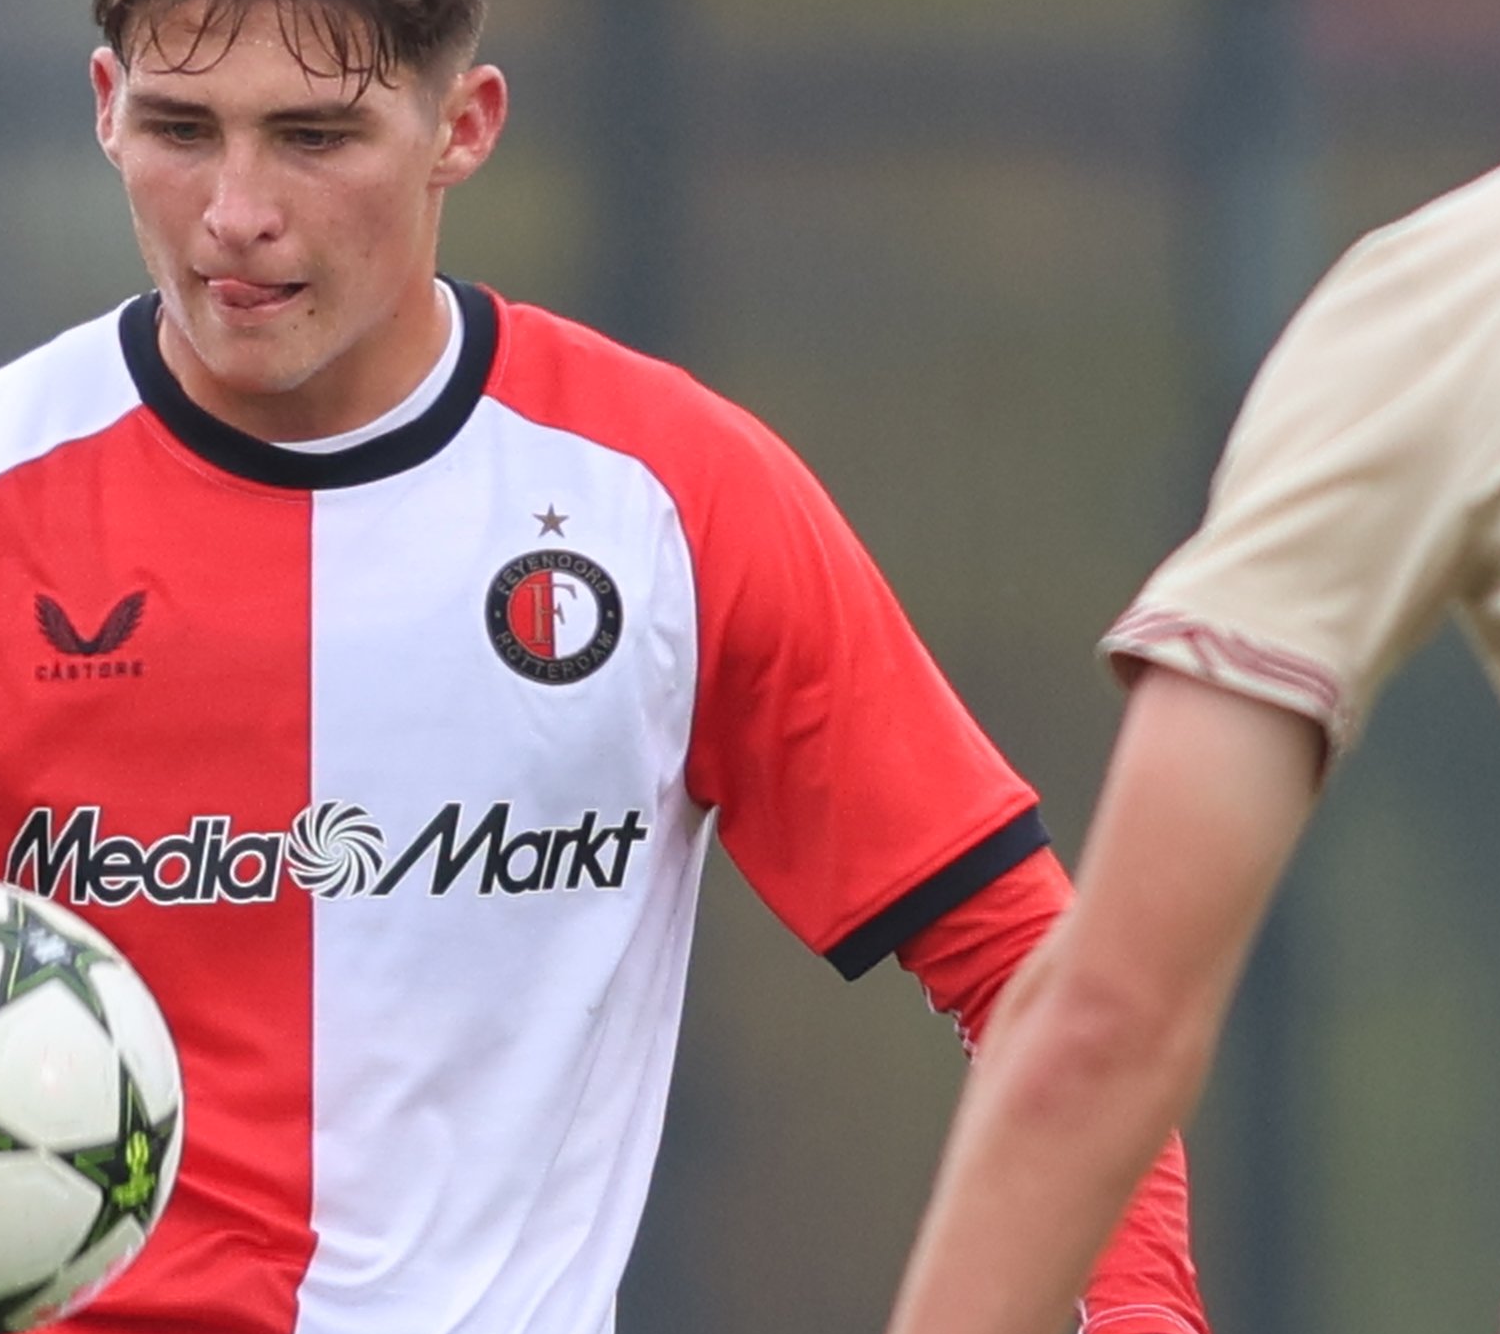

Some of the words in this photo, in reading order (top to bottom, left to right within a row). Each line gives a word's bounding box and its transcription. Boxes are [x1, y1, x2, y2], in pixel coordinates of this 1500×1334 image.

[498, 554, 612, 596] FEYENOORD
[34, 660, 143, 681] CASTORE
[495, 630, 614, 679] ROTTERDAM
[5, 806, 284, 904] Media
[371, 801, 648, 898] Markt
